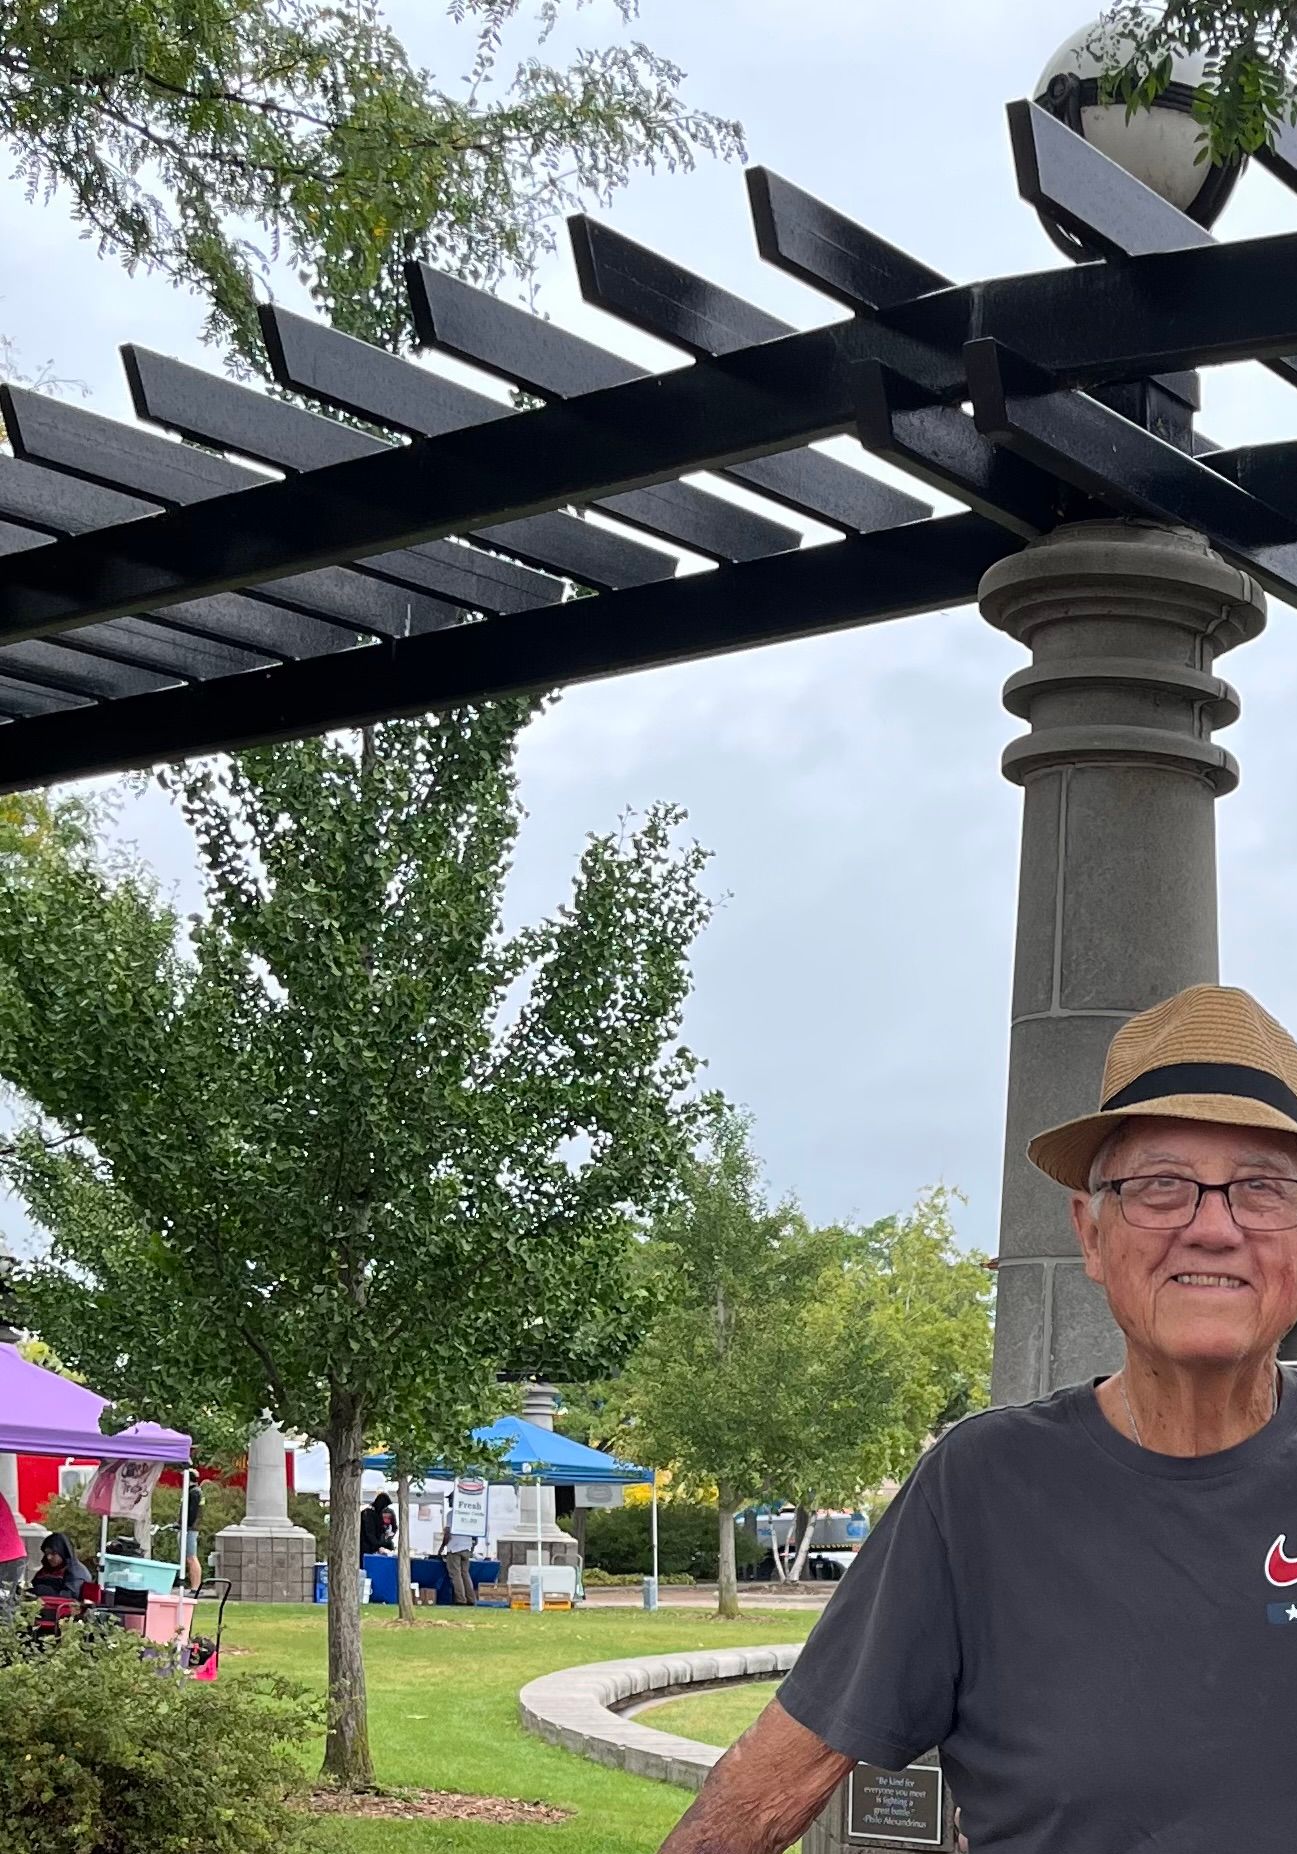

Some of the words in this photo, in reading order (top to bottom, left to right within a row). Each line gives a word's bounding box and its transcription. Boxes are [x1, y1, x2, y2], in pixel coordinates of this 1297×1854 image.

[458, 1501, 481, 1510] Fresh
[889, 1777, 904, 1787] kind
[864, 1787, 894, 1795] everyone
[895, 1790, 908, 1798] you
[909, 1790, 927, 1798] meet
[883, 1796, 908, 1807] fighting
[873, 1807, 890, 1816] great
[884, 1817, 927, 1828] Alexandrinus
